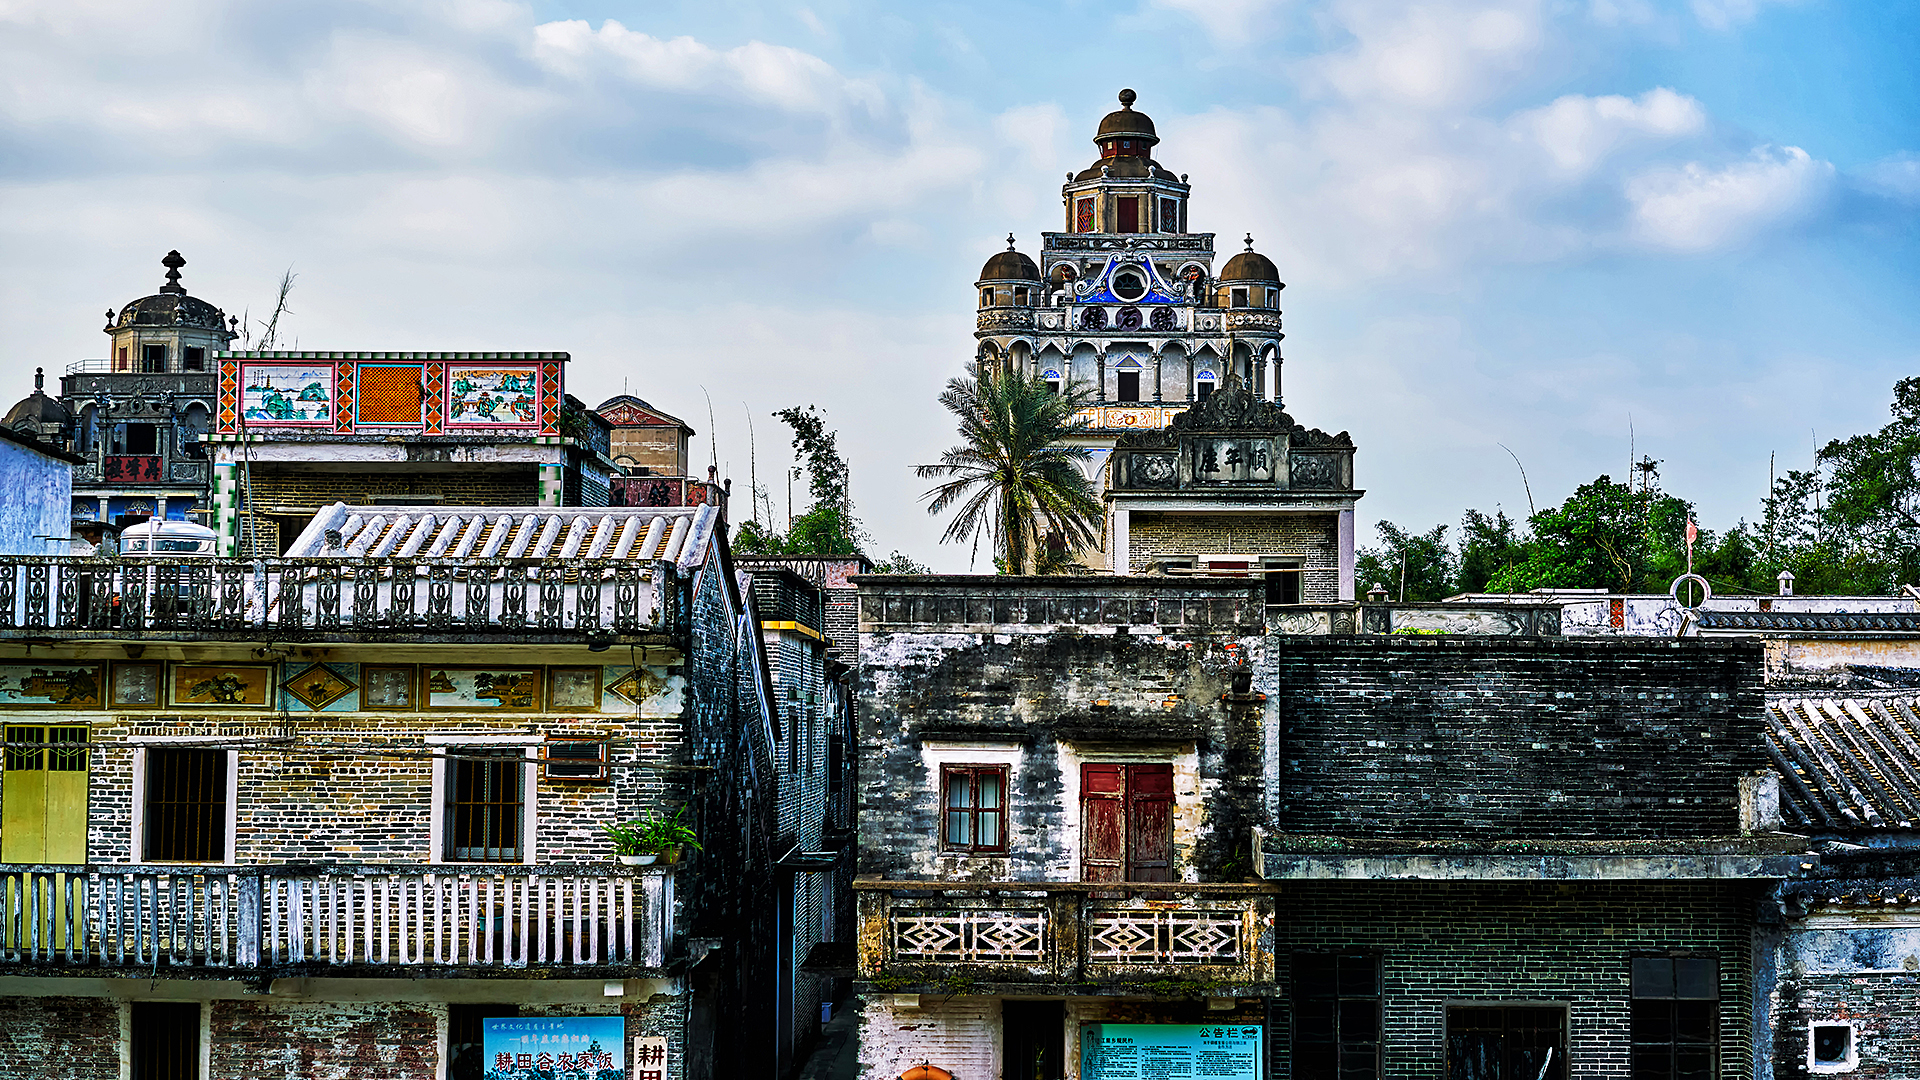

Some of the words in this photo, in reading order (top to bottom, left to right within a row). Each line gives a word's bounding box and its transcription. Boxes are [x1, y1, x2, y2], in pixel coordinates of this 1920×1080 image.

[1199, 1027, 1239, 1038] 公告栏
[494, 1051, 615, 1072] 耕田谷农家饭
